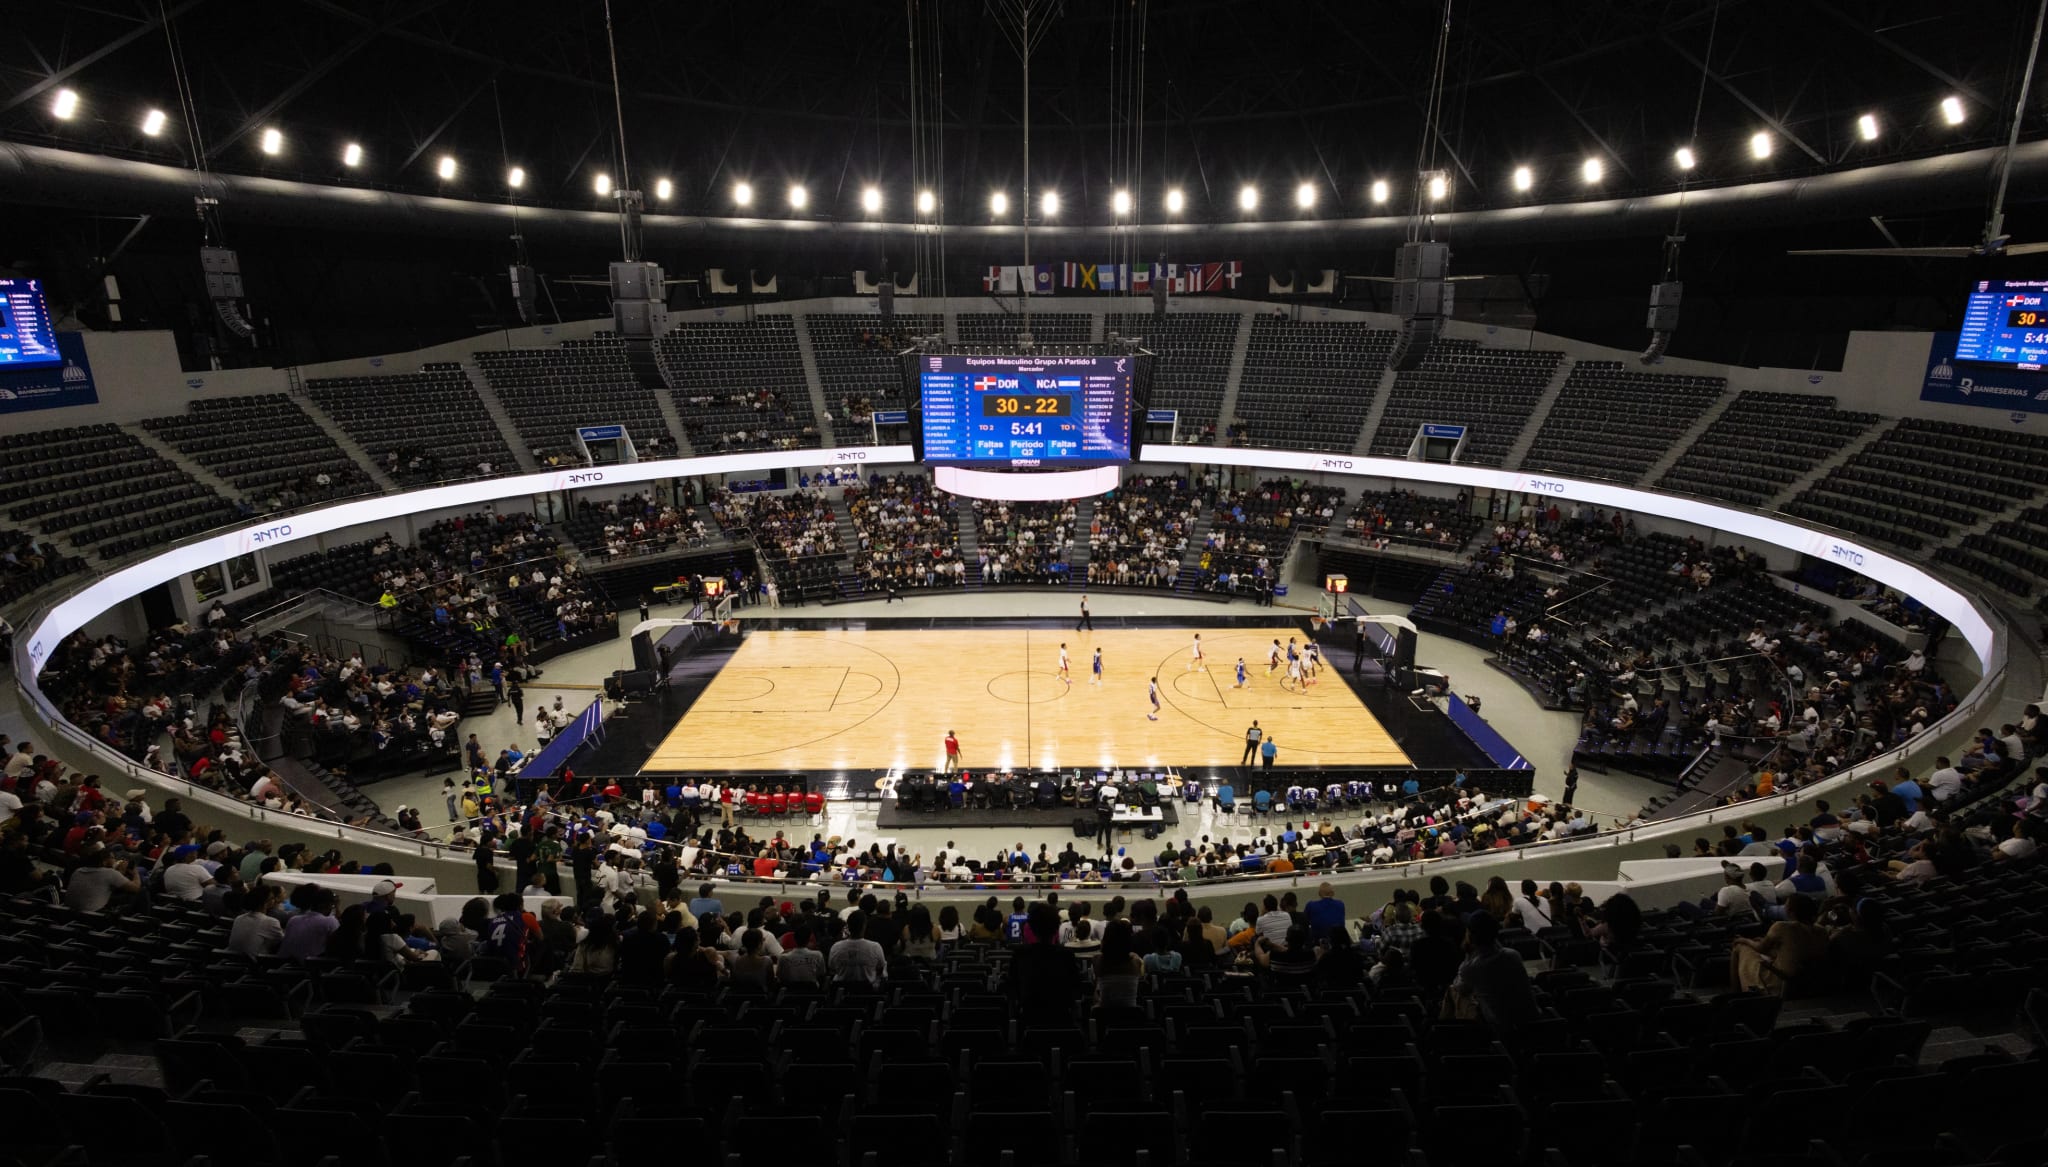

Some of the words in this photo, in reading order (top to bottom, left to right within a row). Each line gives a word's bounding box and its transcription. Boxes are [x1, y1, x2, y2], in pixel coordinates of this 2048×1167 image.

[2024, 298, 2041, 306] DOM
[2018, 312, 2036, 325] 30
[2024, 333, 2048, 343] 5:41
[966, 358, 995, 366] Equipos
[1035, 358, 1056, 366] Grupo
[998, 379, 1018, 389] DOM
[1036, 379, 1057, 389] NCA
[1973, 385, 2029, 397] BANRESERVAS
[996, 398, 1018, 413] 30
[1036, 398, 1058, 413] 22
[1011, 422, 1042, 435] 5:41
[978, 440, 1004, 448] Faltas
[1012, 440, 1044, 448] Periodo
[1052, 440, 1076, 448] Faltas
[1295, 791, 1300, 799] 2
[1353, 786, 1358, 794] 7
[1011, 921, 1020, 938] 2
[491, 923, 506, 947] 4
